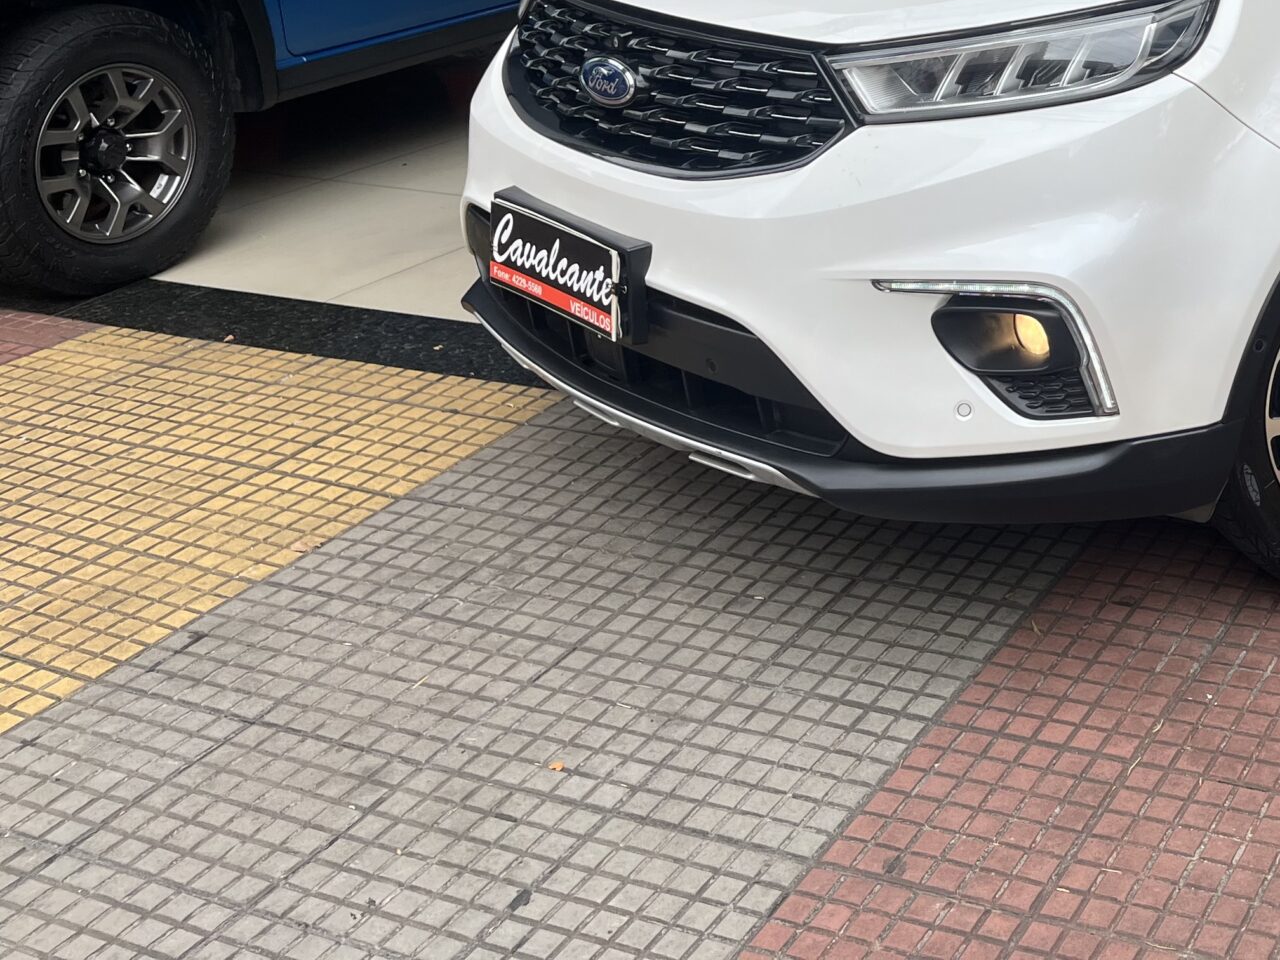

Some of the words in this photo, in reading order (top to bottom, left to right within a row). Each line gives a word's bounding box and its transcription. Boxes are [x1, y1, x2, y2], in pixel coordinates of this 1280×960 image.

[588, 66, 620, 95] Ford
[492, 212, 614, 306] Cavalcante
[569, 299, 611, 332] VEÍCULOS
